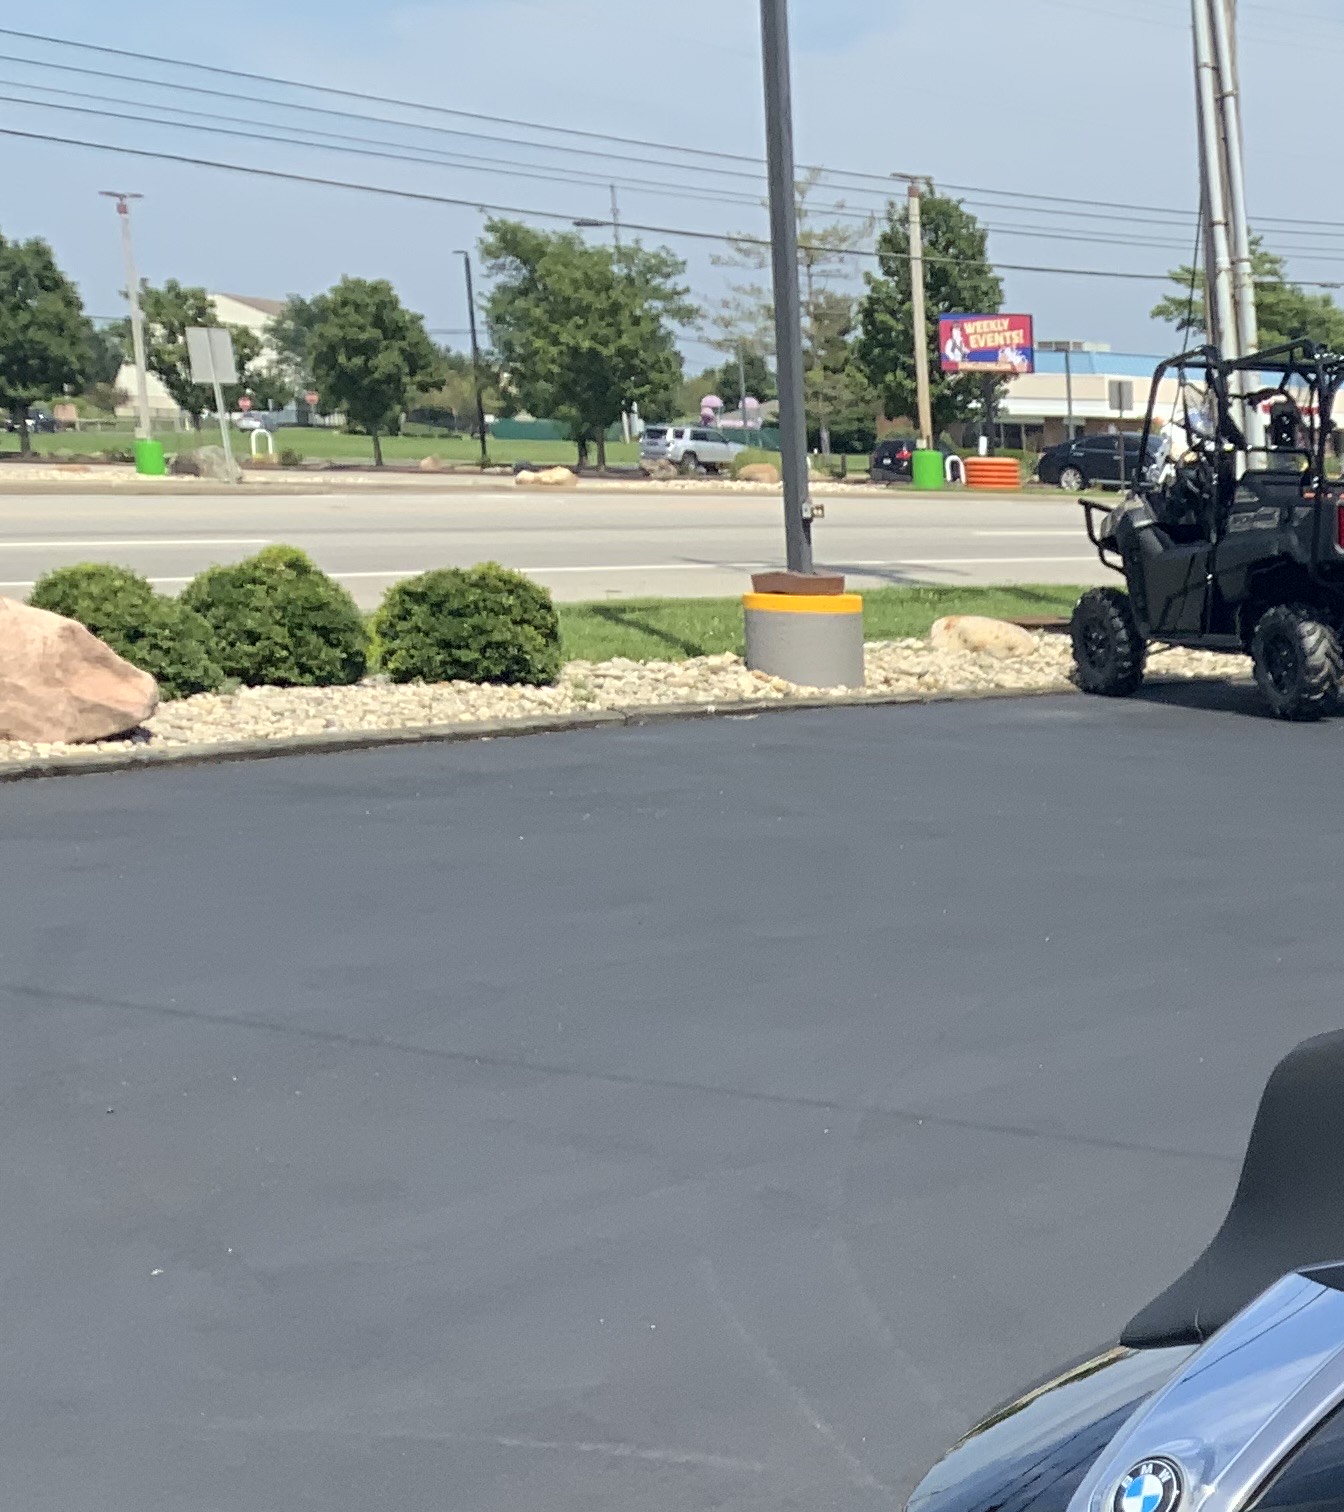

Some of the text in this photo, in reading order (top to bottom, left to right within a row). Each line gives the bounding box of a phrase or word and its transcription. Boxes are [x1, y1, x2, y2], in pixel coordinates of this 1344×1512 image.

[964, 319, 1009, 335] WEEKLY
[969, 329, 1024, 349] EVENTS!
[1121, 1463, 1172, 1489] BMW
